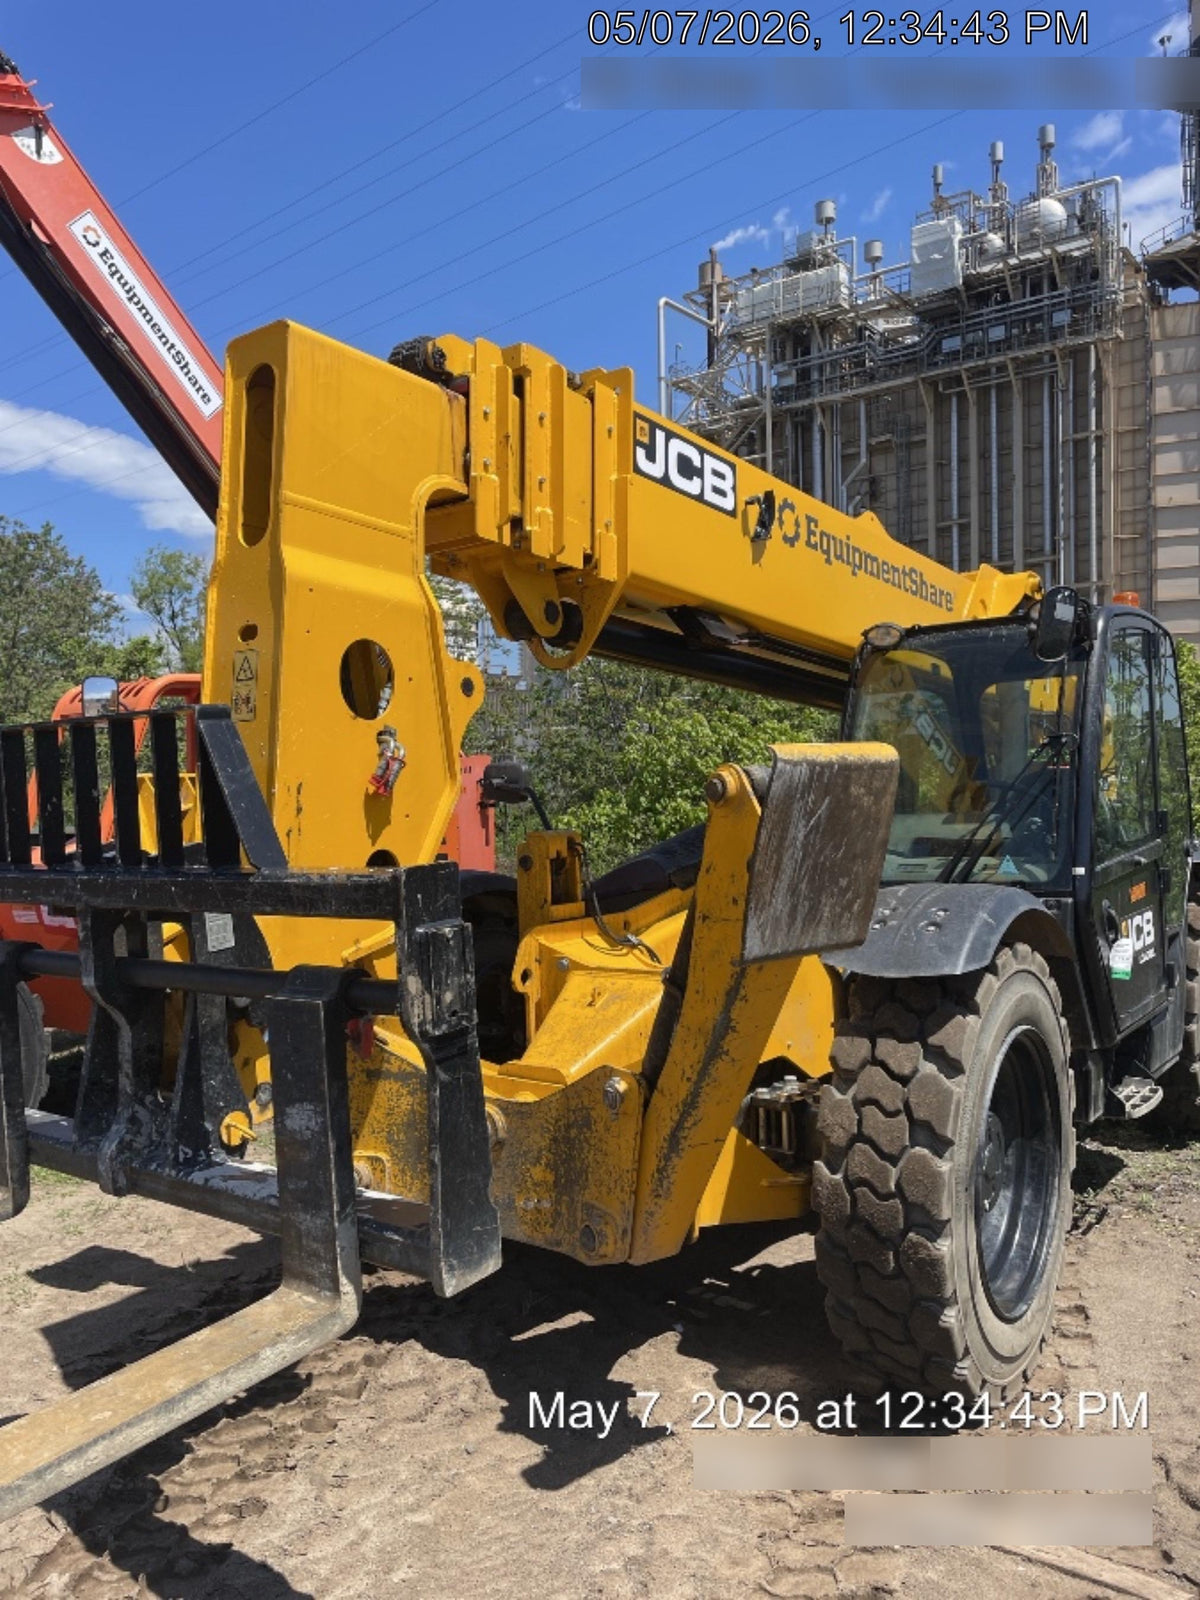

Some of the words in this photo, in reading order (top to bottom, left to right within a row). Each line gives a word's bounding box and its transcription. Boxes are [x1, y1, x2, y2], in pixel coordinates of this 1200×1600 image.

[99, 247, 213, 406] EquipmentShare
[636, 428, 736, 512] JCB
[805, 514, 954, 612] EquipmentShare
